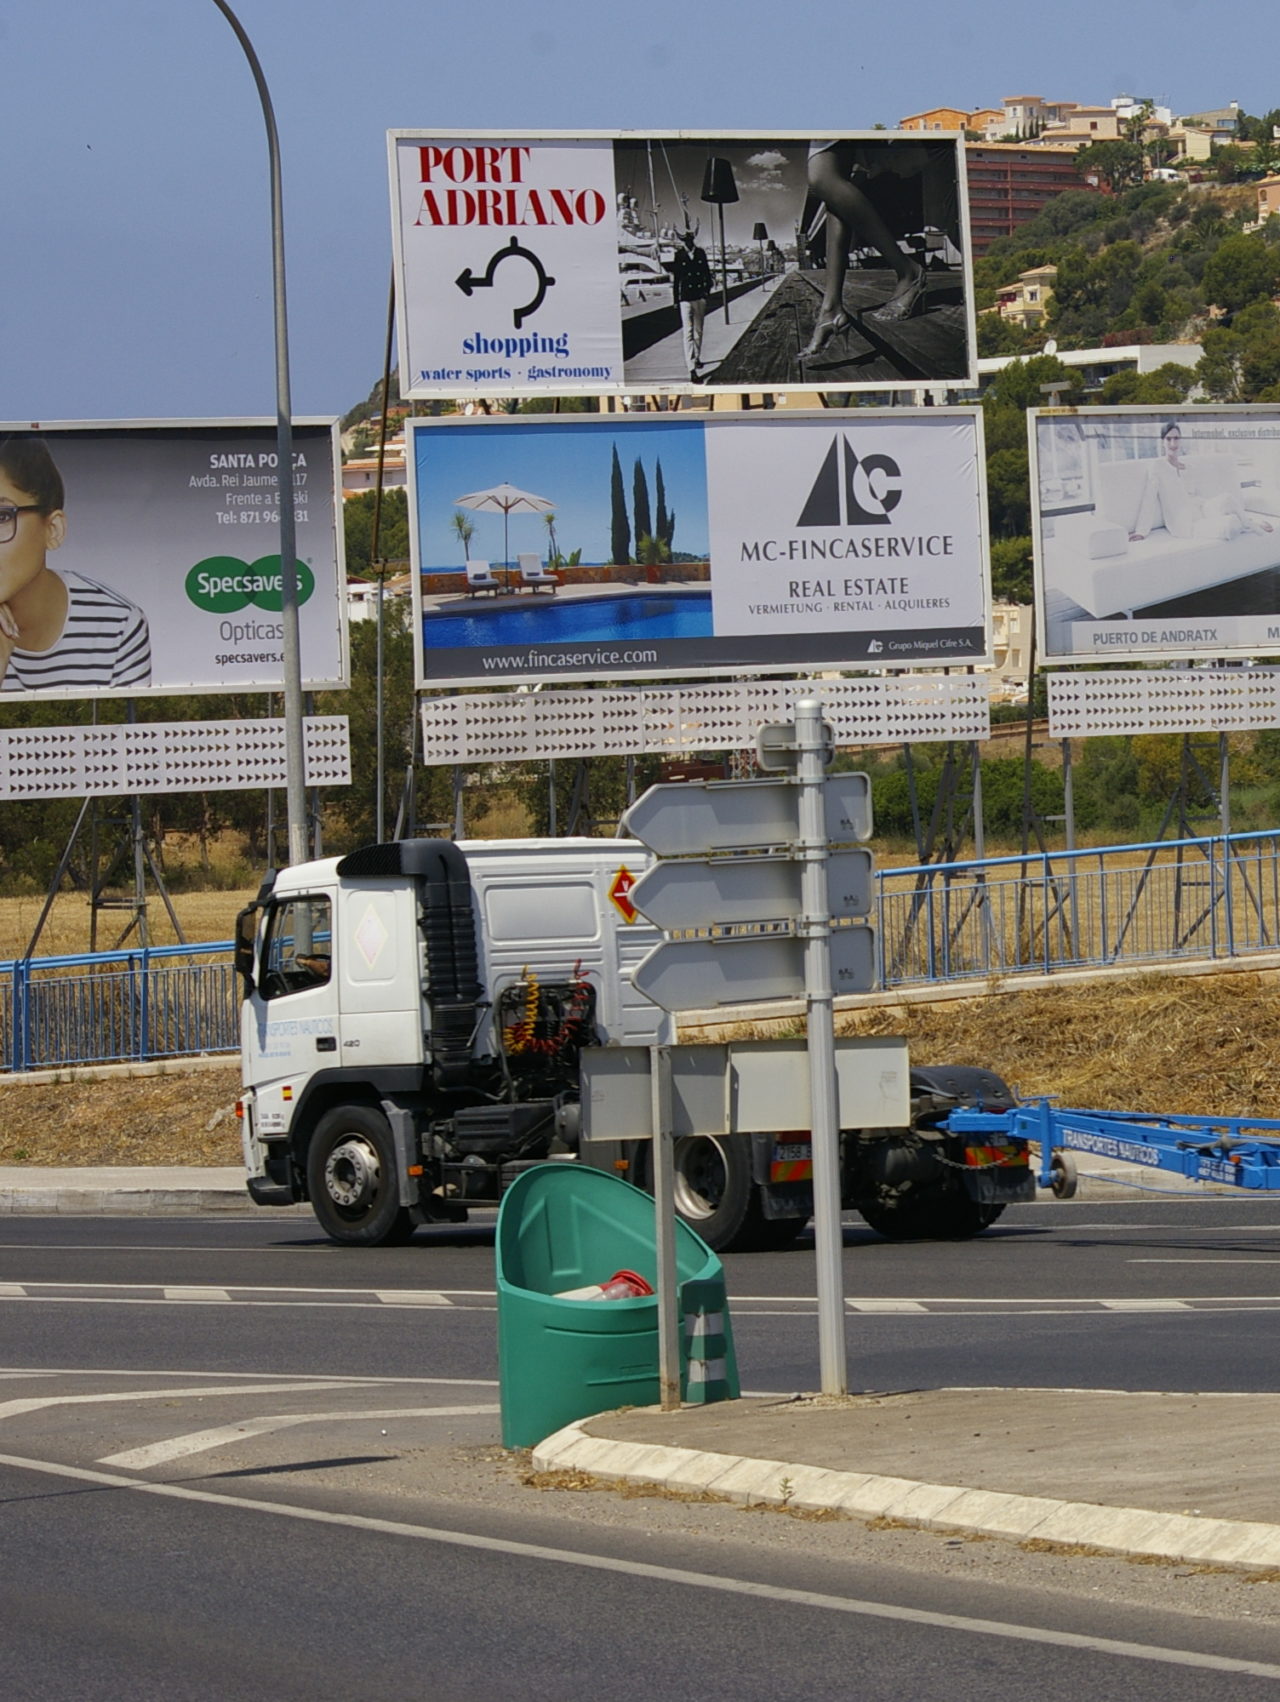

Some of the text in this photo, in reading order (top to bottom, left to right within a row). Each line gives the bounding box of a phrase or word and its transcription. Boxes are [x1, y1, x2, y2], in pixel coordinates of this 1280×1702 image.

[418, 146, 531, 184] PORT
[413, 188, 606, 226] ADRIANO
[462, 332, 570, 358] shopping
[420, 365, 613, 382] water sports gastronomy
[209, 453, 307, 471] SANTA POA
[188, 475, 220, 488] Avda.
[221, 473, 240, 487] Rei
[242, 474, 278, 487] Jaume
[225, 491, 309, 506] Frente a Eski
[216, 511, 238, 524] Tel:
[239, 511, 260, 524] 871
[740, 535, 954, 562] MC-FINCASERVICE
[197, 572, 303, 598] Specsaves
[789, 577, 910, 598] REAL ESTATE
[748, 598, 951, 616] VERMIETUNG RENTAL ALQUILERES
[219, 620, 284, 645] Opticas
[1093, 628, 1218, 646] PUERTO DE ANDRATX
[888, 641, 913, 652] Grupo
[958, 638, 973, 648] S.A.
[482, 648, 658, 670] www.fincaservice.com
[343, 1039, 361, 1048] 420
[1062, 1129, 1118, 1157] TRANSPORTES
